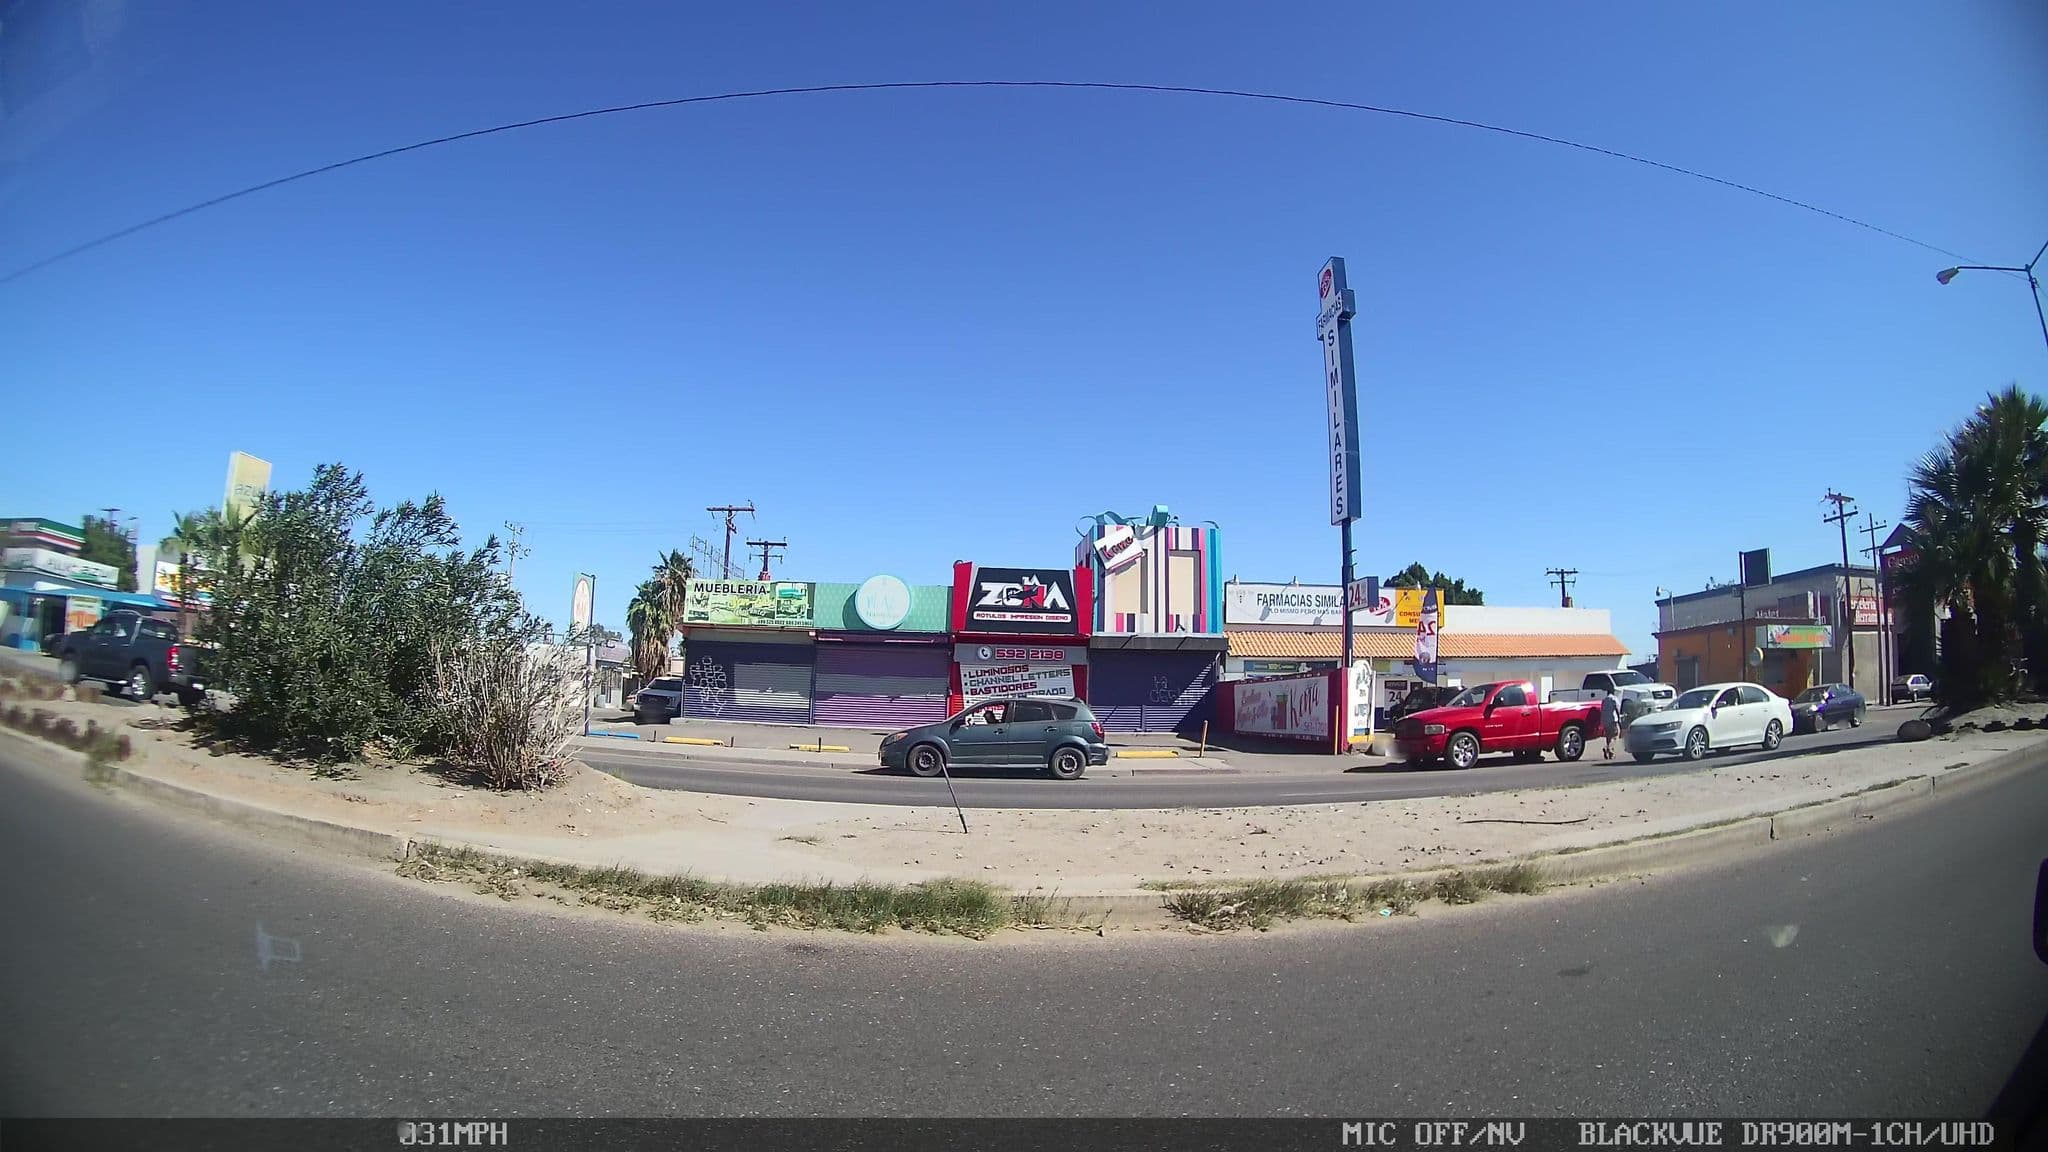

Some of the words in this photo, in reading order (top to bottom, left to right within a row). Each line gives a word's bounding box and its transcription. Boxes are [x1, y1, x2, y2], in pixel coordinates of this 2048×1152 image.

[1327, 329, 1344, 515] SIMILARES
[1257, 593, 1313, 607] FARMACIAS
[1315, 594, 1344, 607] SIMILA
[1348, 583, 1361, 608] 24
[995, 648, 1026, 660] 592
[968, 665, 1030, 679] LUMINOSOS
[969, 675, 1019, 688] CHANNEL
[1021, 668, 1071, 681] LETTERS
[970, 681, 1037, 696] BASTIDORES
